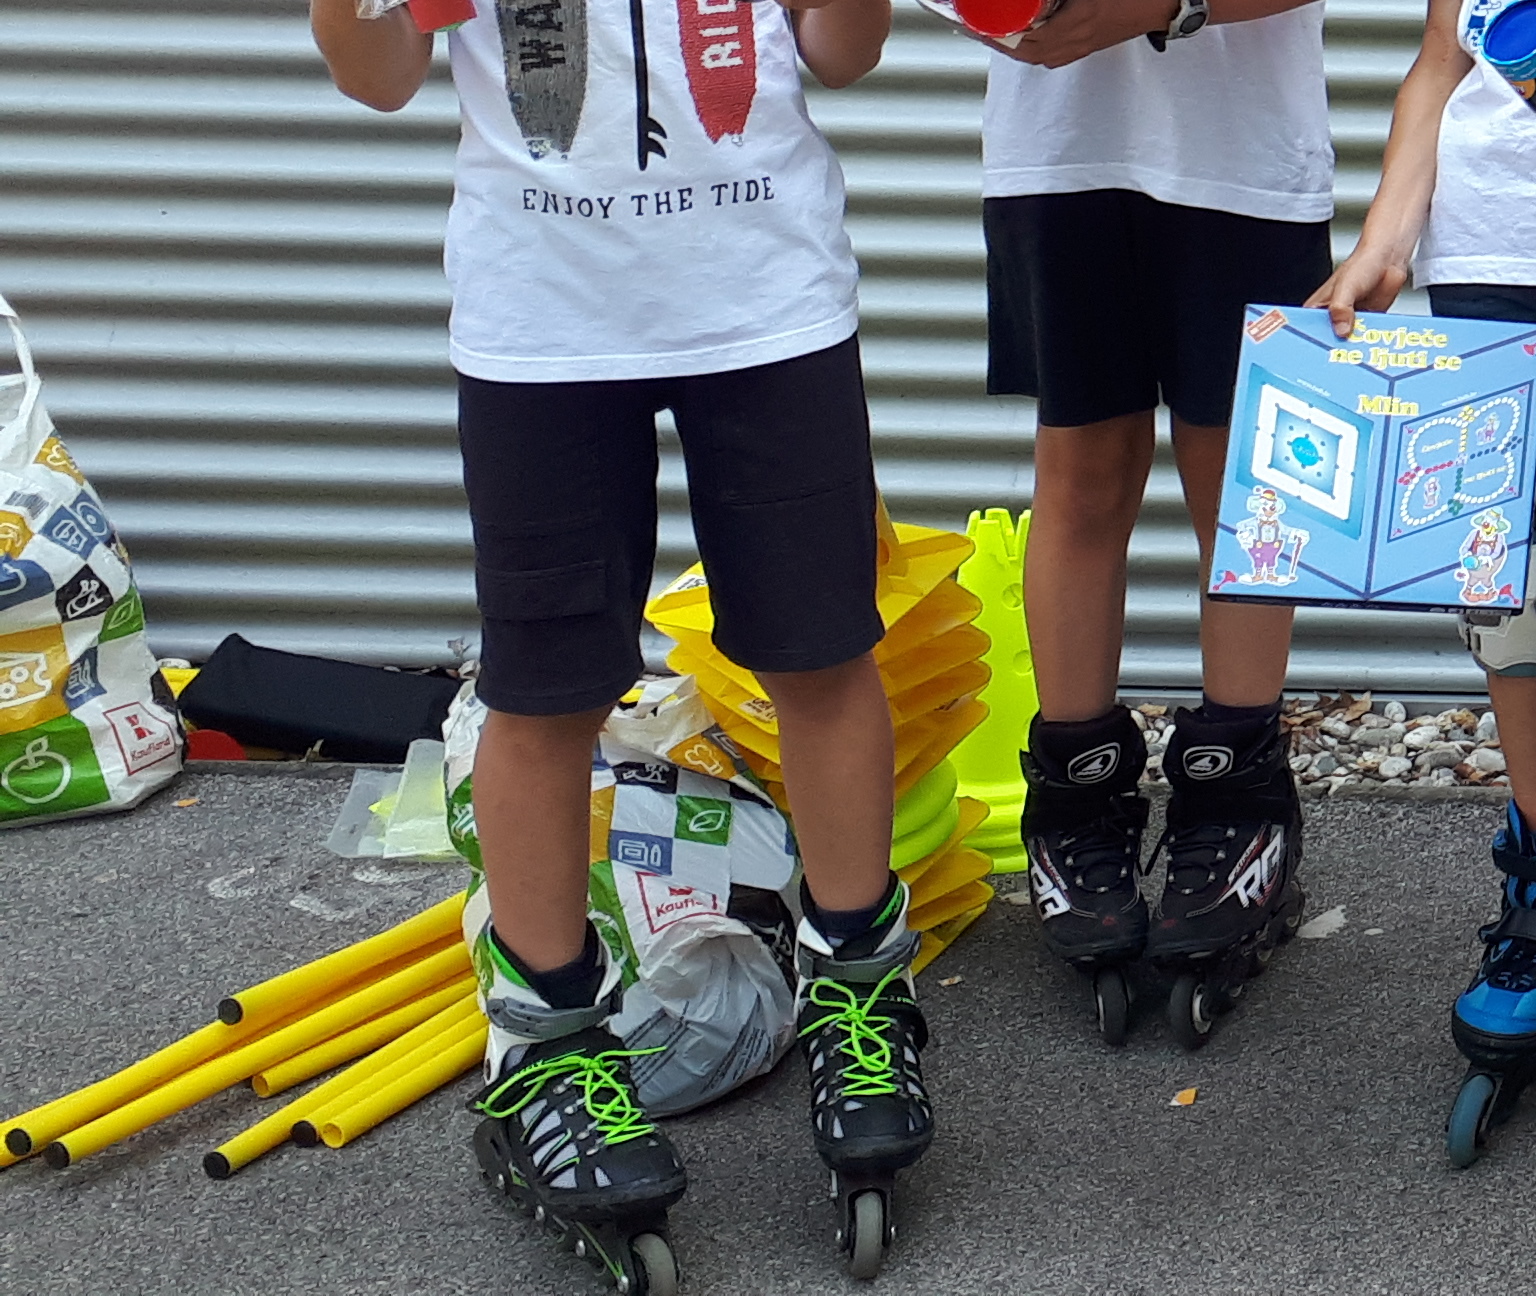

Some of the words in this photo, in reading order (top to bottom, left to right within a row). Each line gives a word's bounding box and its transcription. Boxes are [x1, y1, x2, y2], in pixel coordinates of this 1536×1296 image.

[522, 188, 616, 218] ENJOY
[631, 188, 693, 216] THE
[711, 177, 775, 206] TIDE
[1348, 318, 1449, 349] Čovječe
[1329, 348, 1364, 364] ne
[1369, 347, 1428, 370] ljuti
[1433, 355, 1462, 371] se
[1356, 394, 1420, 416] Mlin
